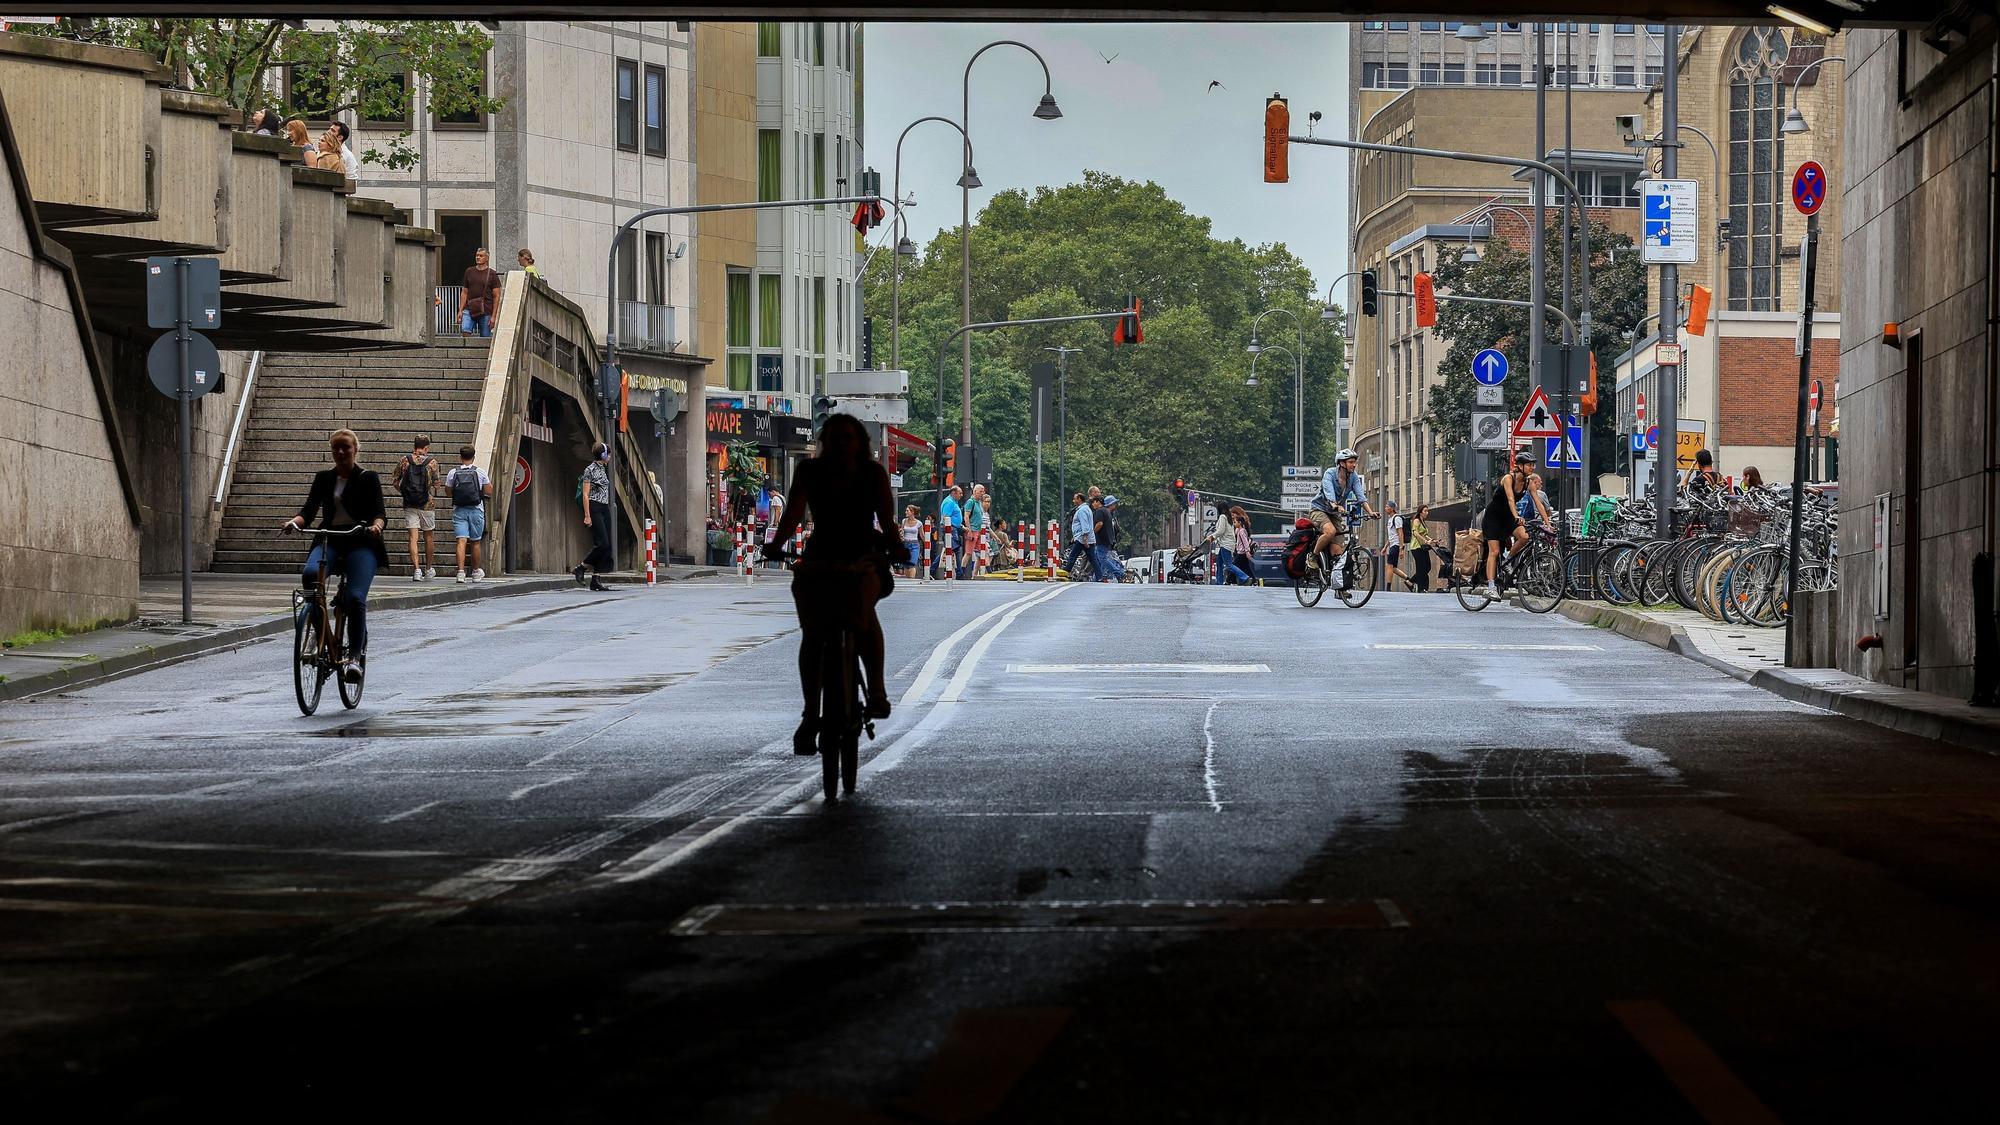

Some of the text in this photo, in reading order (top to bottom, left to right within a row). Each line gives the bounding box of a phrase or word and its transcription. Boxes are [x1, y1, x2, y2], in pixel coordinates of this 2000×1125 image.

[1418, 285, 1426, 316] FABEMA
[628, 374, 687, 394] NFORMATION
[716, 412, 742, 435] VAPE
[1634, 435, 1645, 449] U
